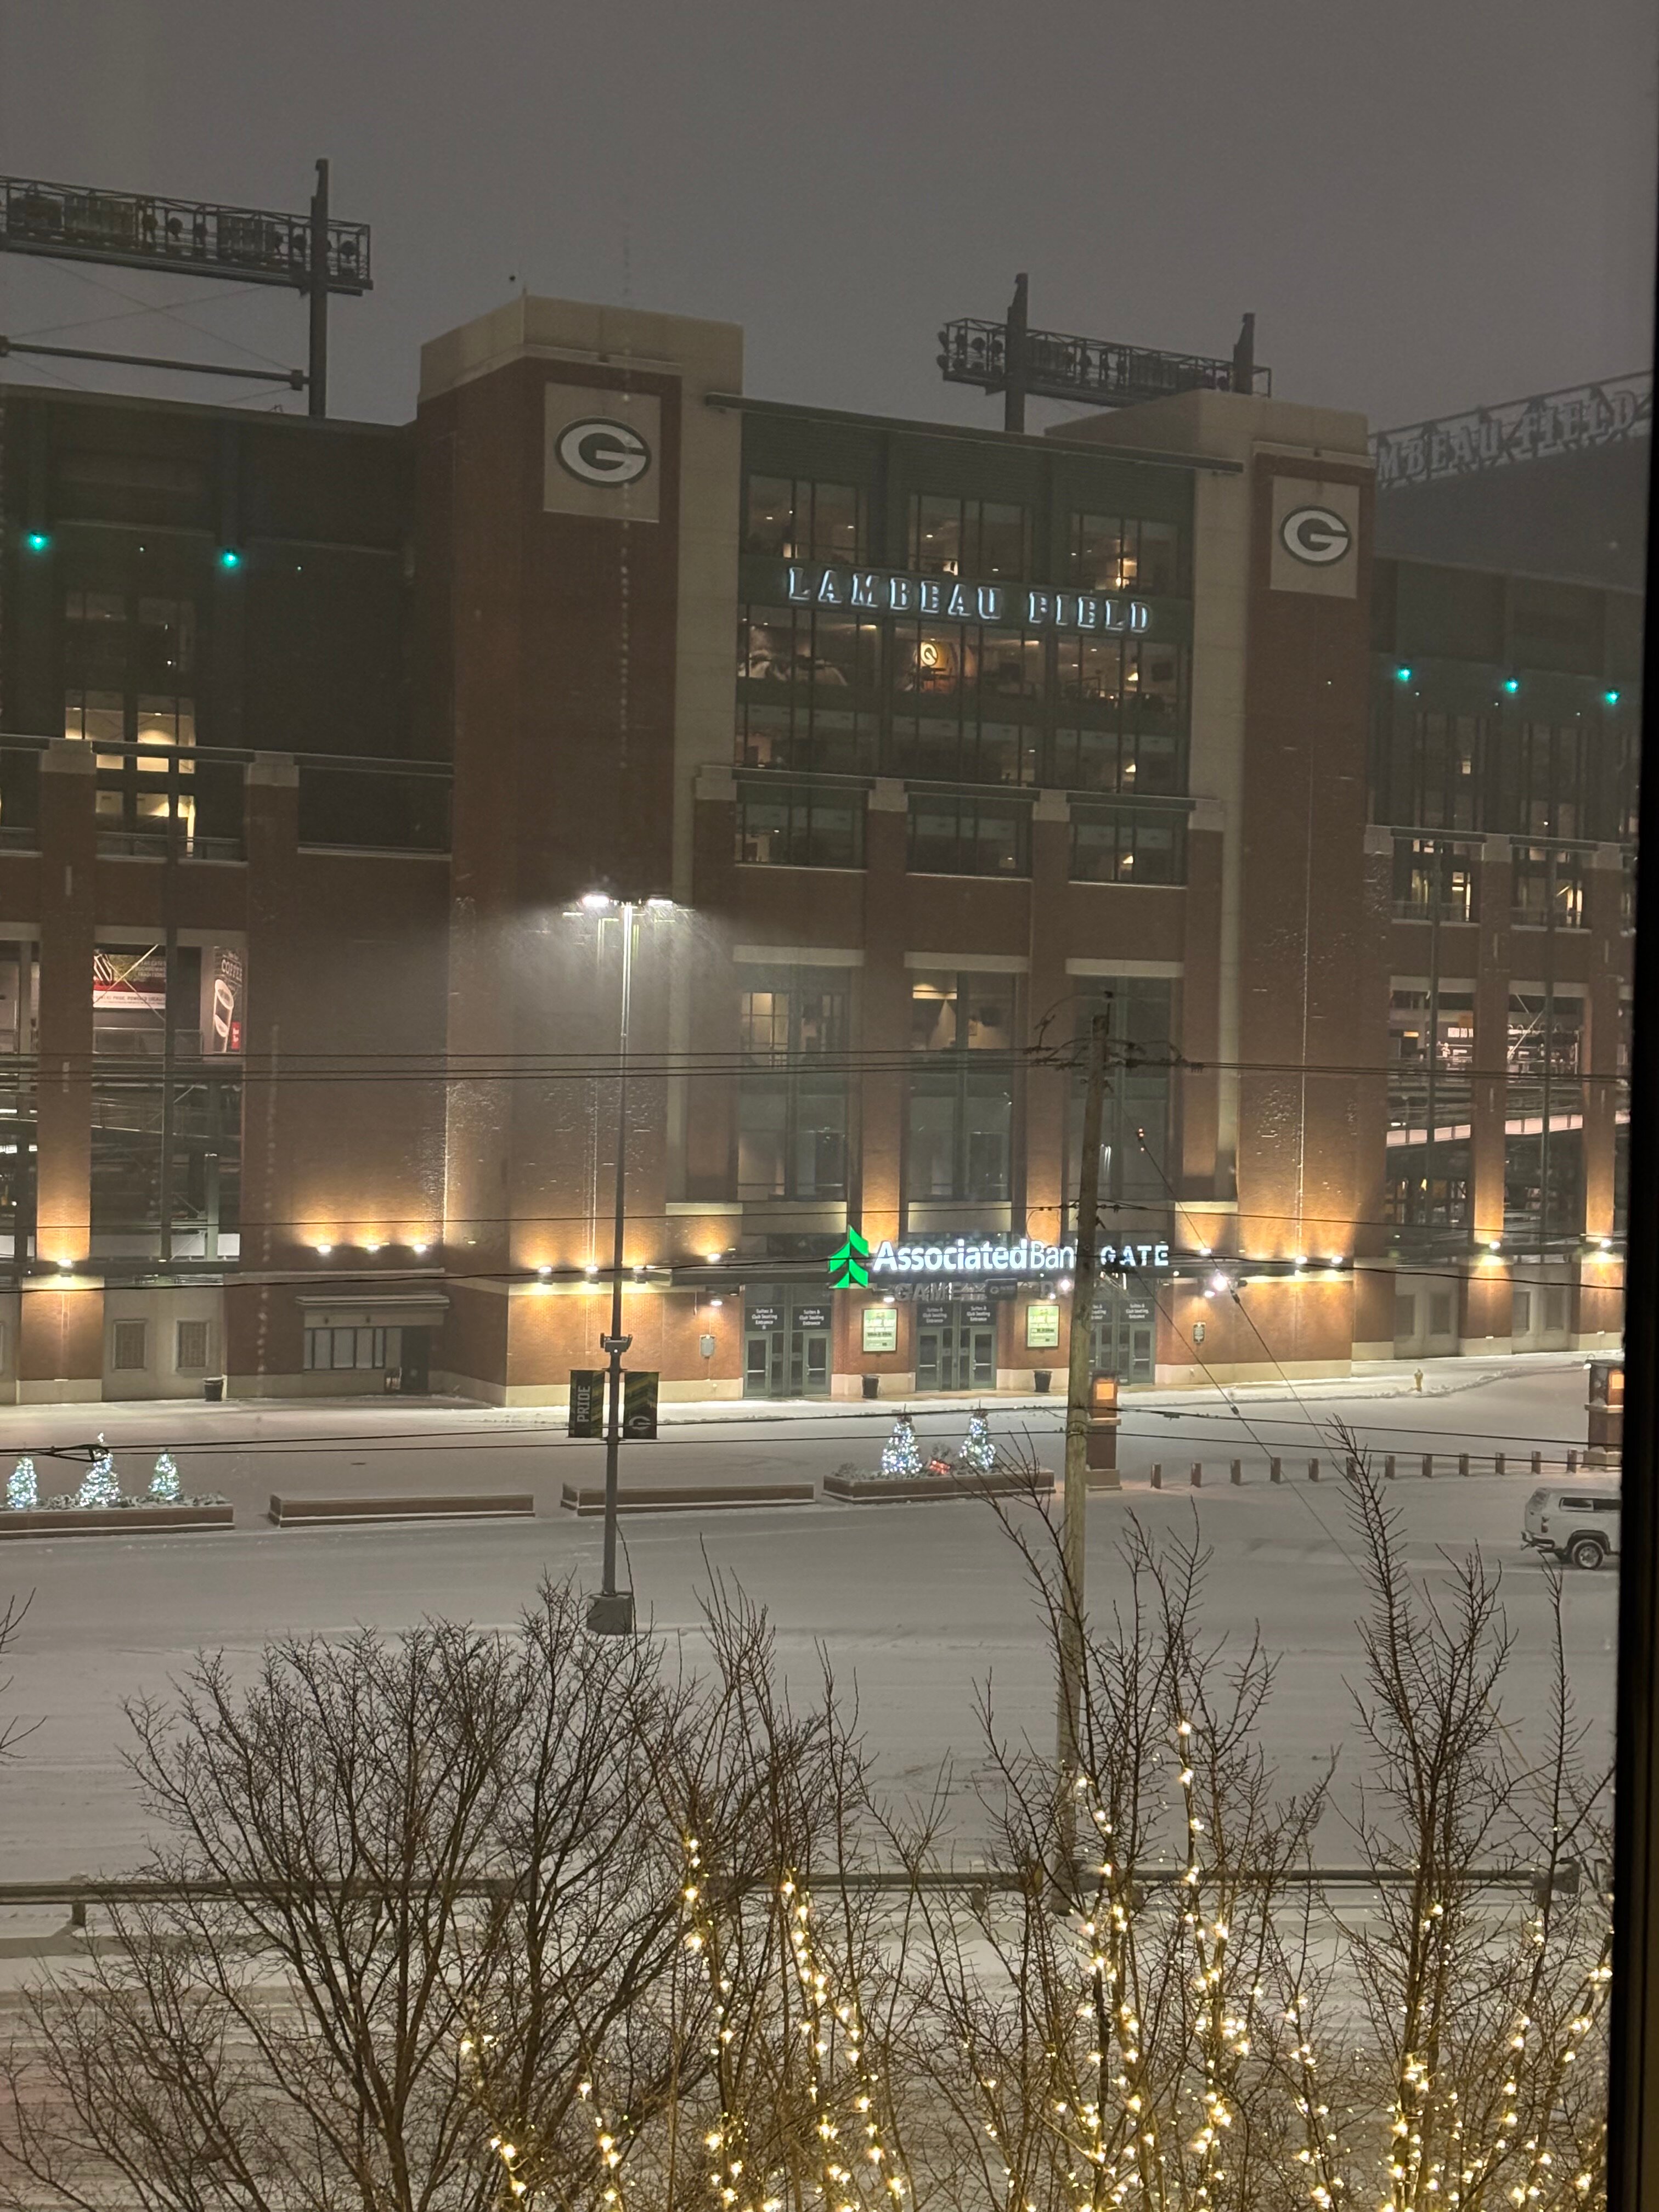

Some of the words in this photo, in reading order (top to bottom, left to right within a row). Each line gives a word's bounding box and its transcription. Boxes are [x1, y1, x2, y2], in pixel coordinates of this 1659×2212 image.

[1378, 421, 1504, 481] MBEAU
[788, 567, 1002, 620] LAMBEAU
[1029, 591, 1151, 633] FIELD
[221, 959, 243, 983] COFFEE
[873, 1238, 1077, 1272] AssociatedBan
[1101, 1244, 1170, 1267] GATE
[577, 1385, 591, 1423] PRIDE
